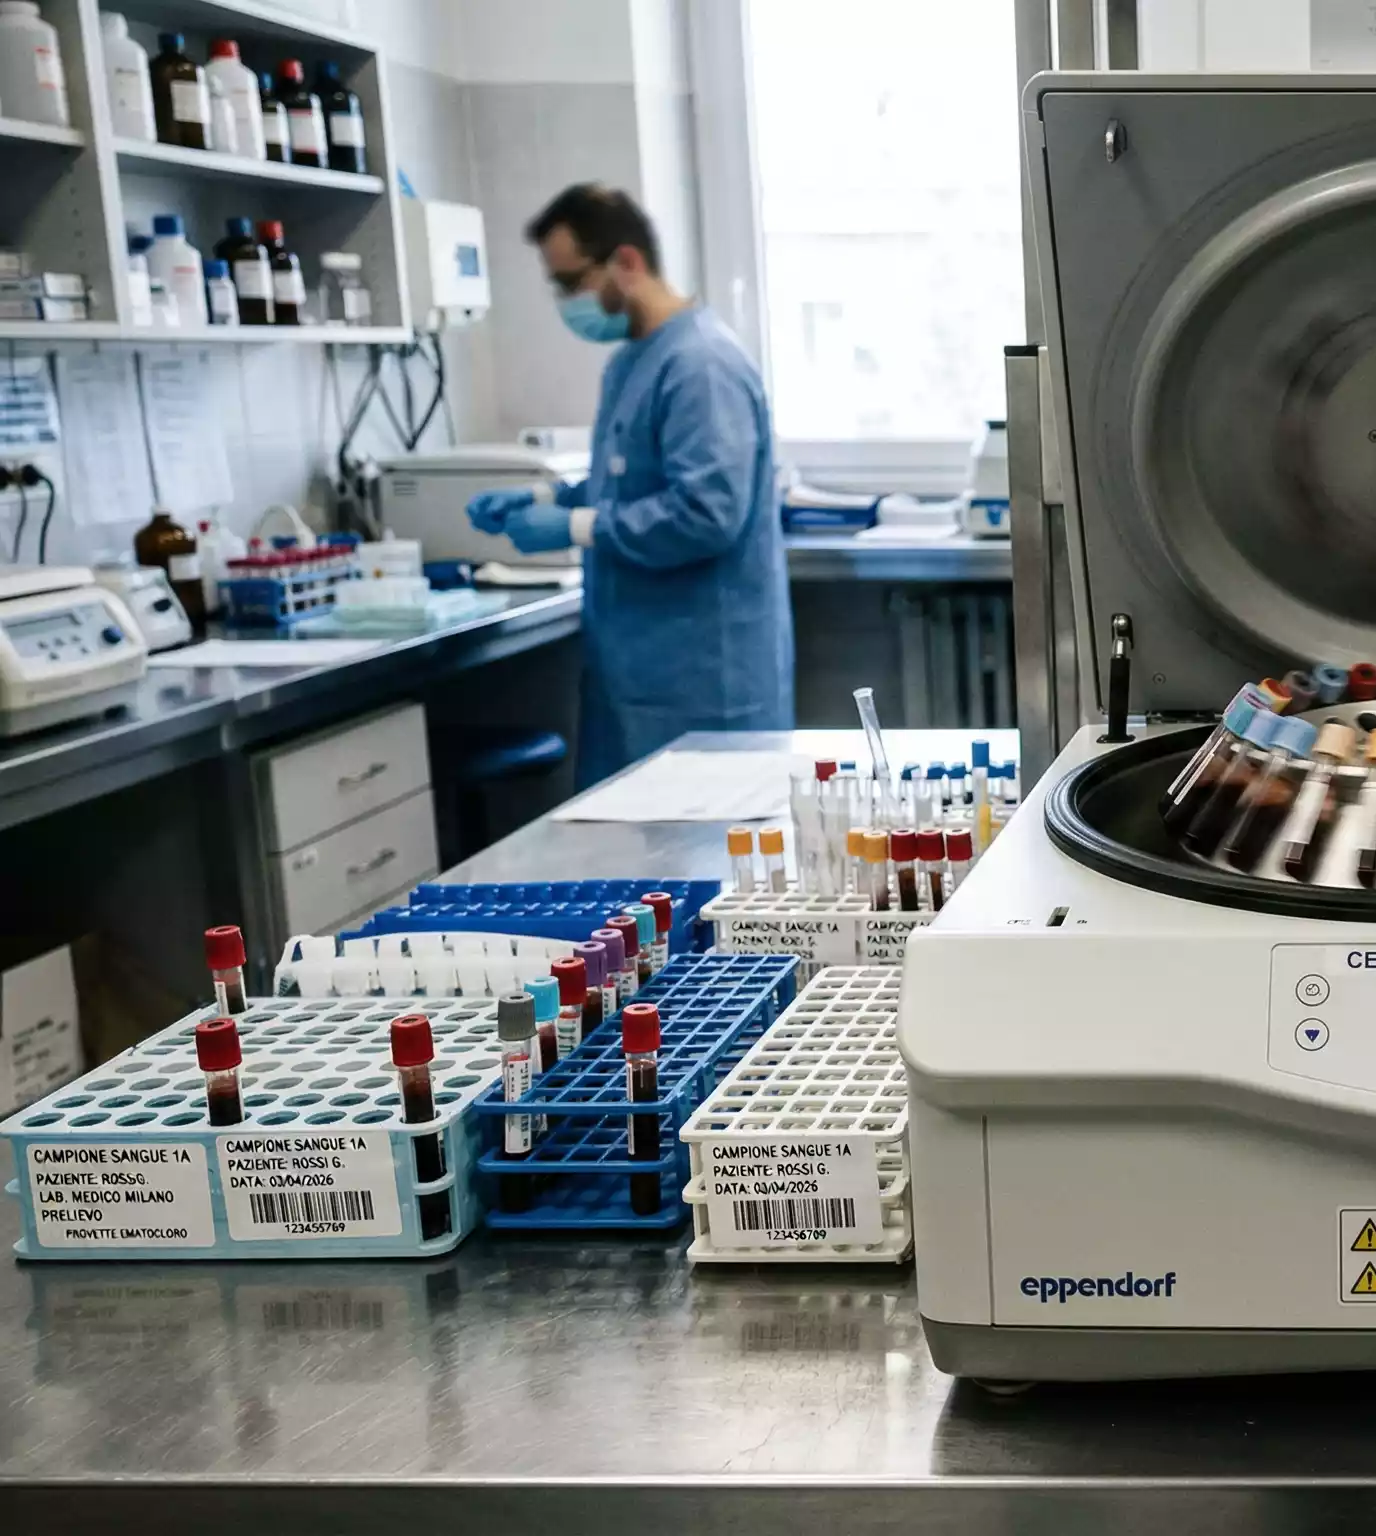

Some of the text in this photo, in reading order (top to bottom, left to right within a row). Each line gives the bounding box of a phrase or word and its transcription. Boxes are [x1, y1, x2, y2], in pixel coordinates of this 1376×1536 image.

[226, 1137, 367, 1153] CAMPIONE SANGUE 1A
[712, 1143, 852, 1159] CAMPIONE SANGUE 1A
[34, 1149, 191, 1163] CAMPIONE SANGUE 1A
[292, 1157, 328, 1169] ROSSI
[777, 1163, 813, 1176] ROSSI
[817, 1162, 830, 1175] G.
[230, 1176, 266, 1188] DATA:
[715, 1183, 750, 1195] DATA:
[39, 1191, 174, 1203] LAB. MEDICO MILANO
[41, 1209, 103, 1222] PRELIEVO
[1020, 1271, 1176, 1303] eppendorf
